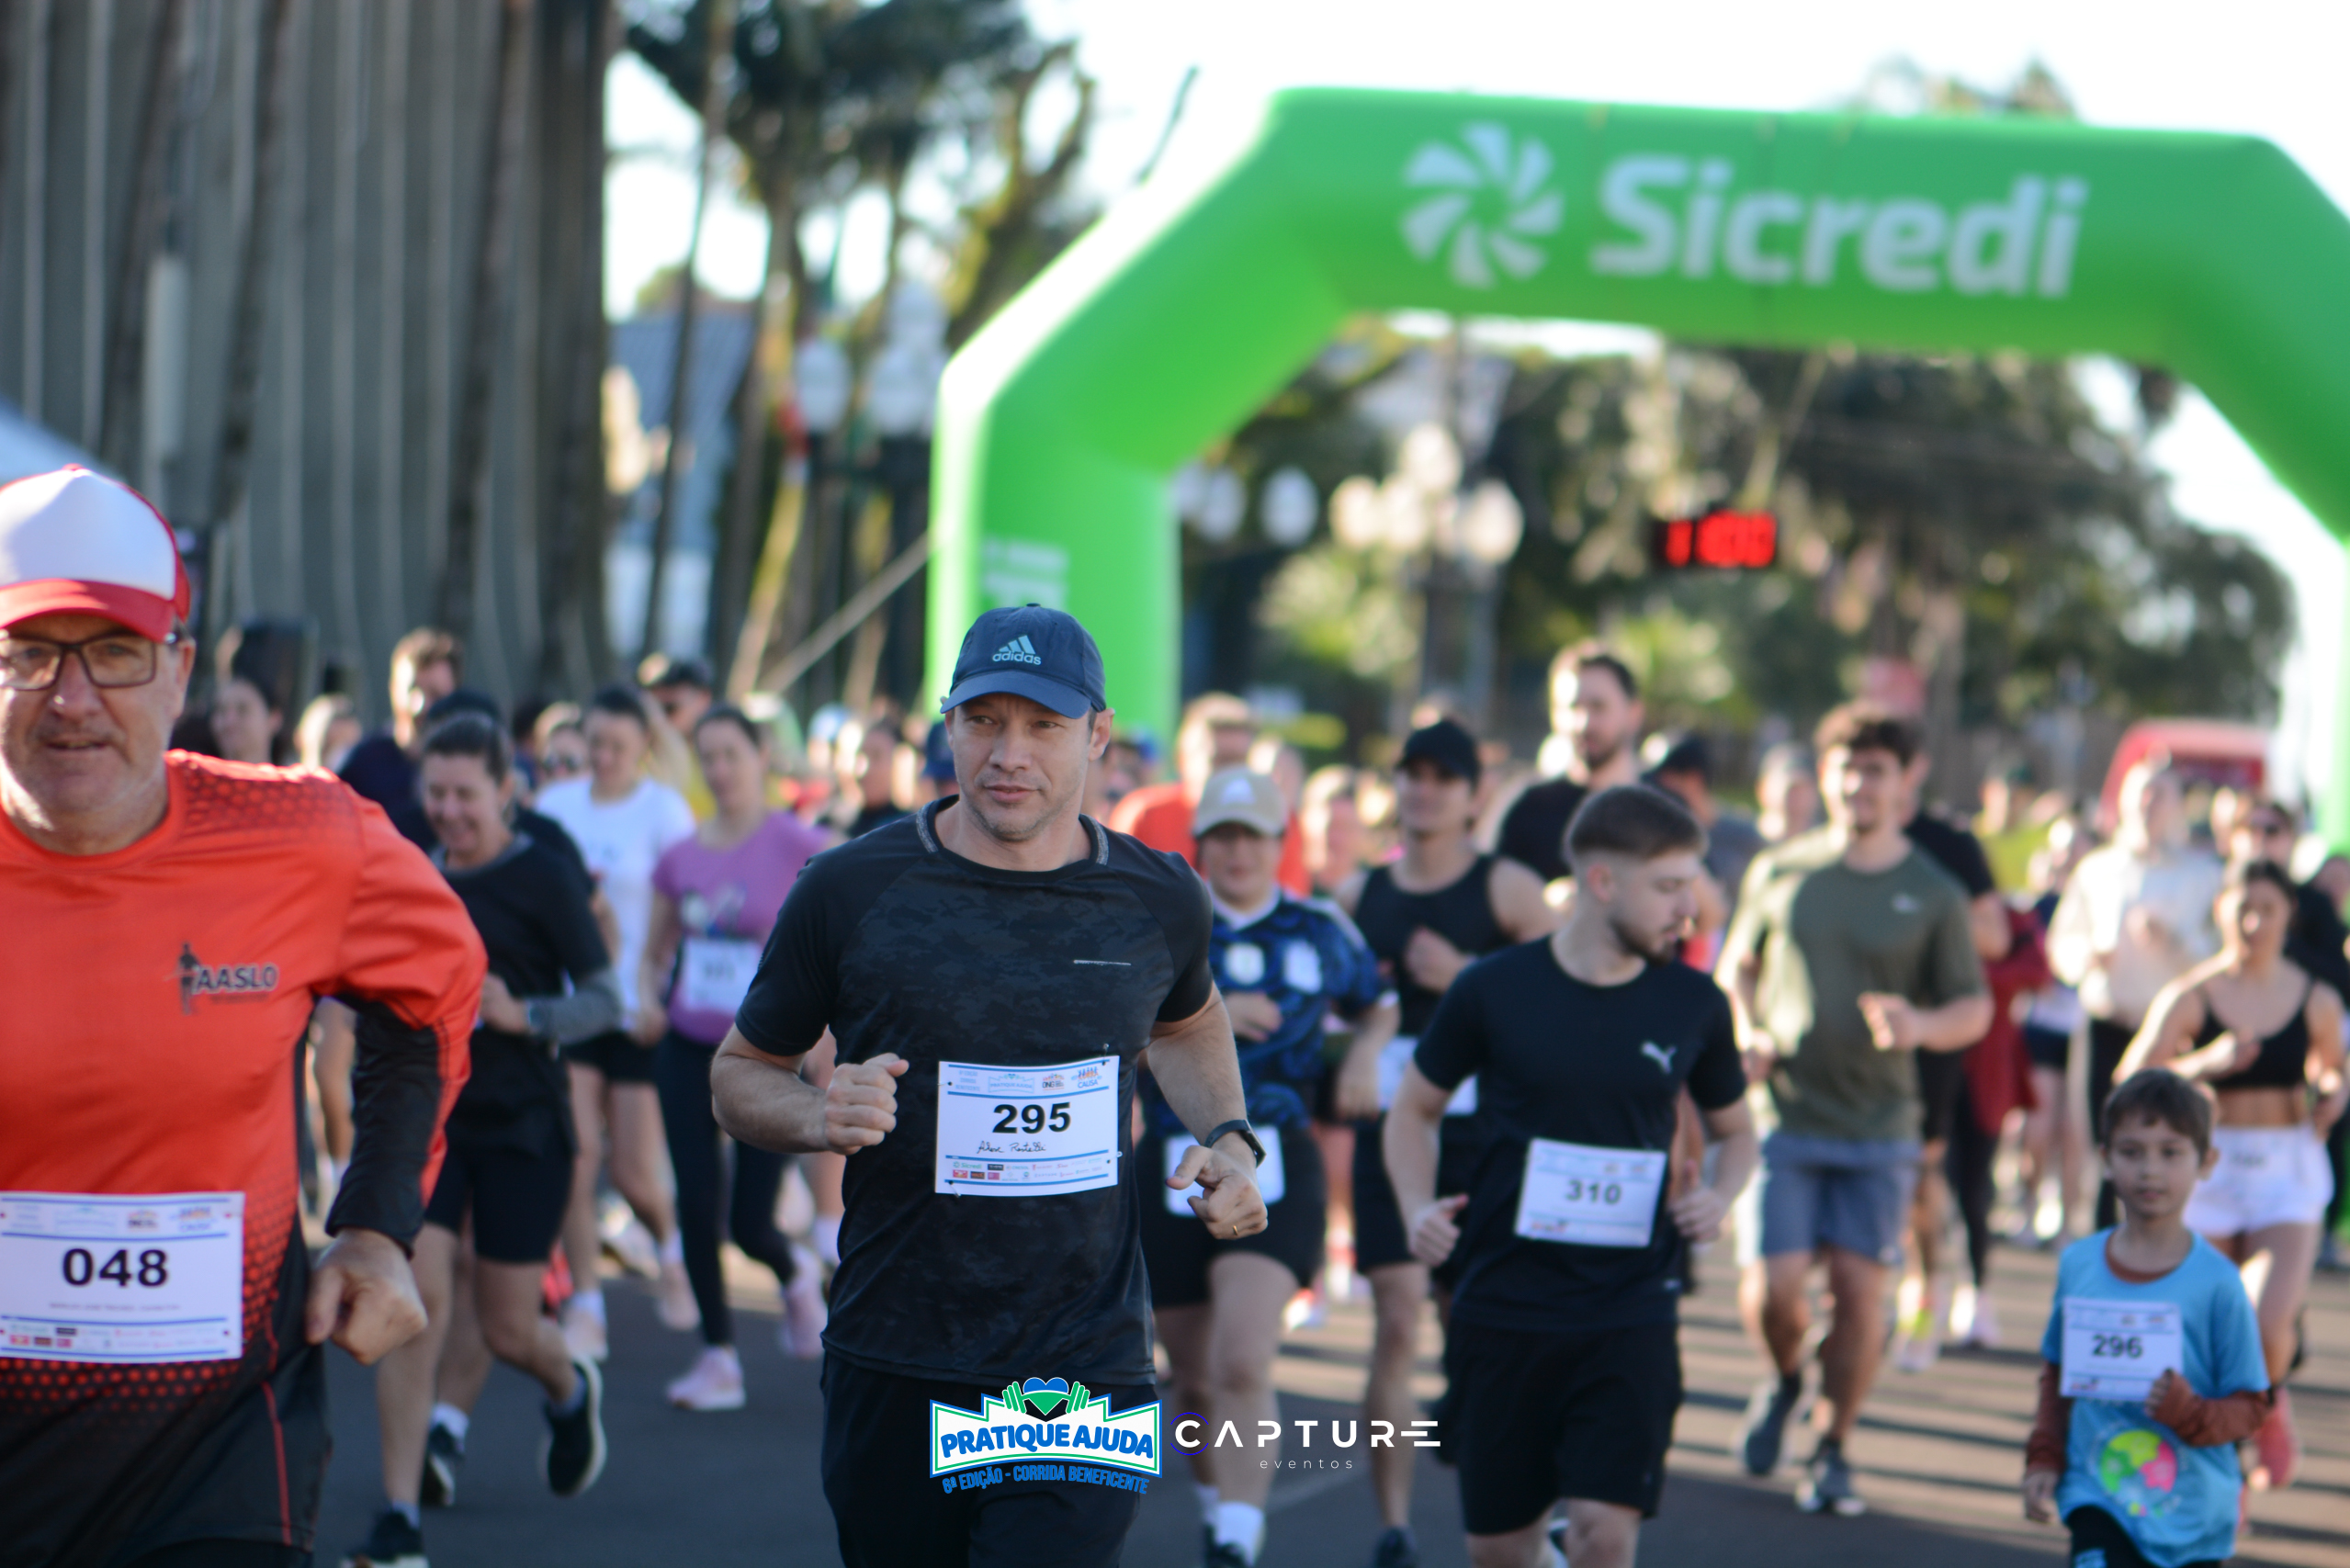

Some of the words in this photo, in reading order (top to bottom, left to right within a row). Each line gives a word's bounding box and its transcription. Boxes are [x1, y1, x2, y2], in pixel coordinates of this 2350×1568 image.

[1589, 152, 2090, 298] Sicredi
[992, 650, 1042, 665] adidas
[194, 964, 278, 993] AASLO
[992, 1102, 1071, 1134] 295
[1565, 1179, 1622, 1205] 310
[62, 1247, 168, 1288] 048
[2091, 1334, 2143, 1359] 296
